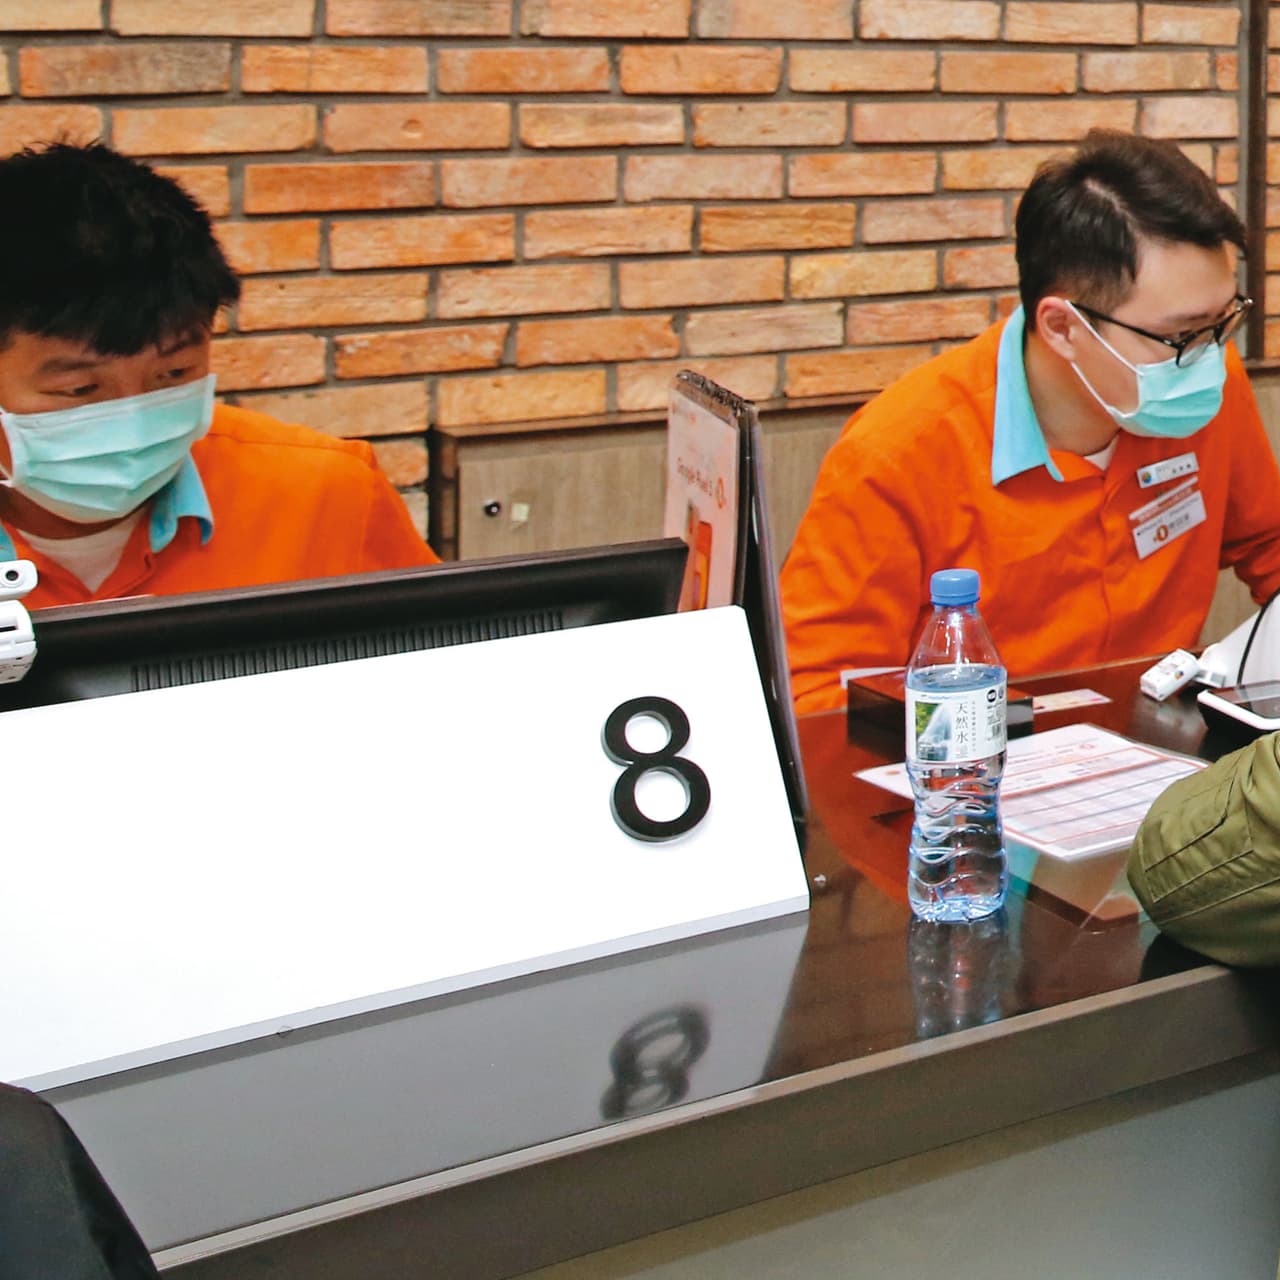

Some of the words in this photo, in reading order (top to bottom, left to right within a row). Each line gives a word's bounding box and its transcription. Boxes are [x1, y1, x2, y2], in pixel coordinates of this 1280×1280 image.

[601, 695, 711, 843] 8
[956, 703, 969, 743] 天然水
